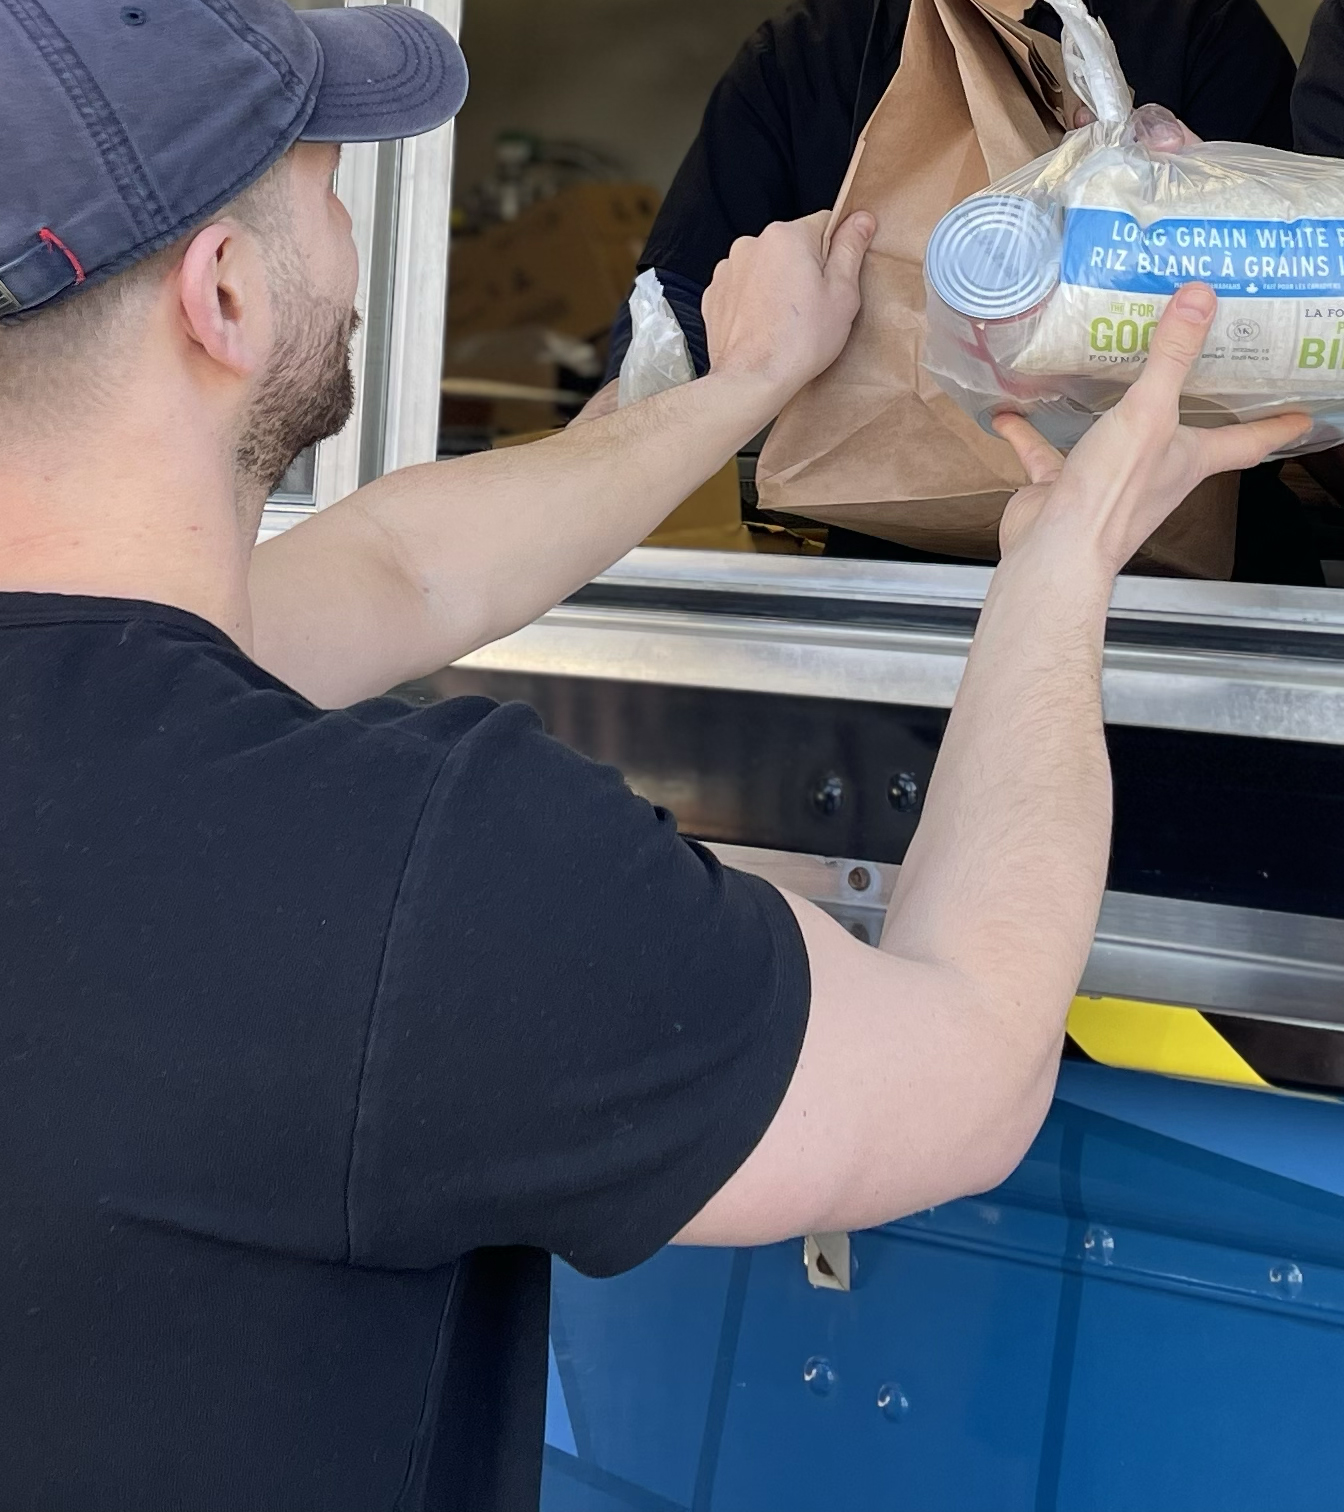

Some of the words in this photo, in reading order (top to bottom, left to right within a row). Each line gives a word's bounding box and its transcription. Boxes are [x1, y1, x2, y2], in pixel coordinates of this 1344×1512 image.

[1176, 227, 1246, 248] GRAIN
[1256, 227, 1329, 248] WHITE
[1090, 246, 1128, 271] RIZ
[1137, 253, 1212, 277] BLANC
[1221, 251, 1235, 277] À
[1244, 256, 1330, 277] GRAINS
[1129, 303, 1154, 317] FOR
[1304, 308, 1323, 318] LA
